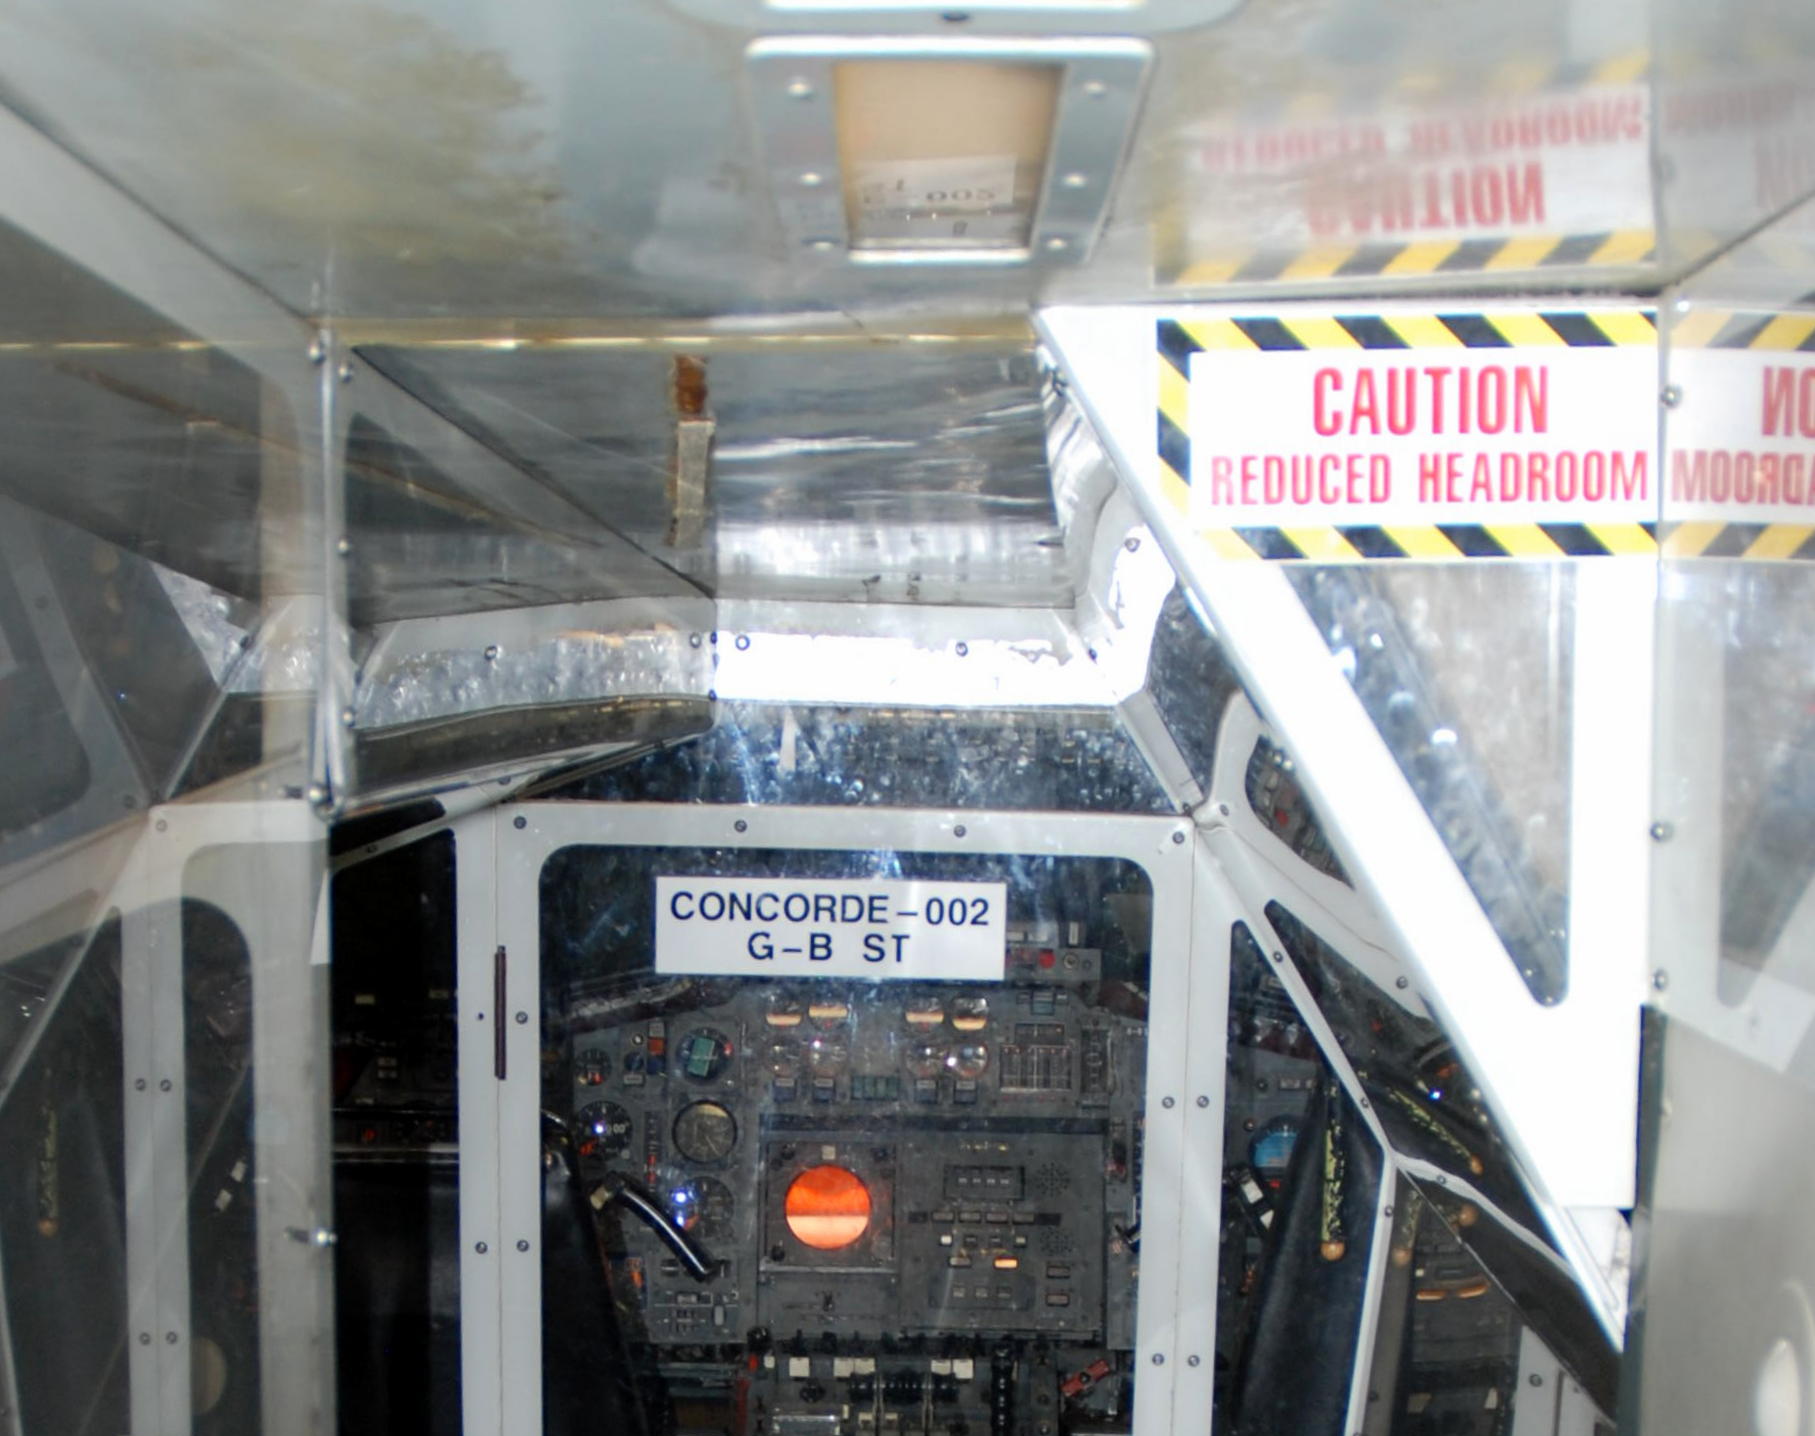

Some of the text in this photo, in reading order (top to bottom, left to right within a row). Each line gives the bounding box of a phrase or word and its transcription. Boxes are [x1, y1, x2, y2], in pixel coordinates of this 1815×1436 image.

[1311, 365, 1550, 437] CAUTION
[1210, 449, 1649, 506] REDUCED HEADROOM
[747, 931, 911, 963] G-B ST
